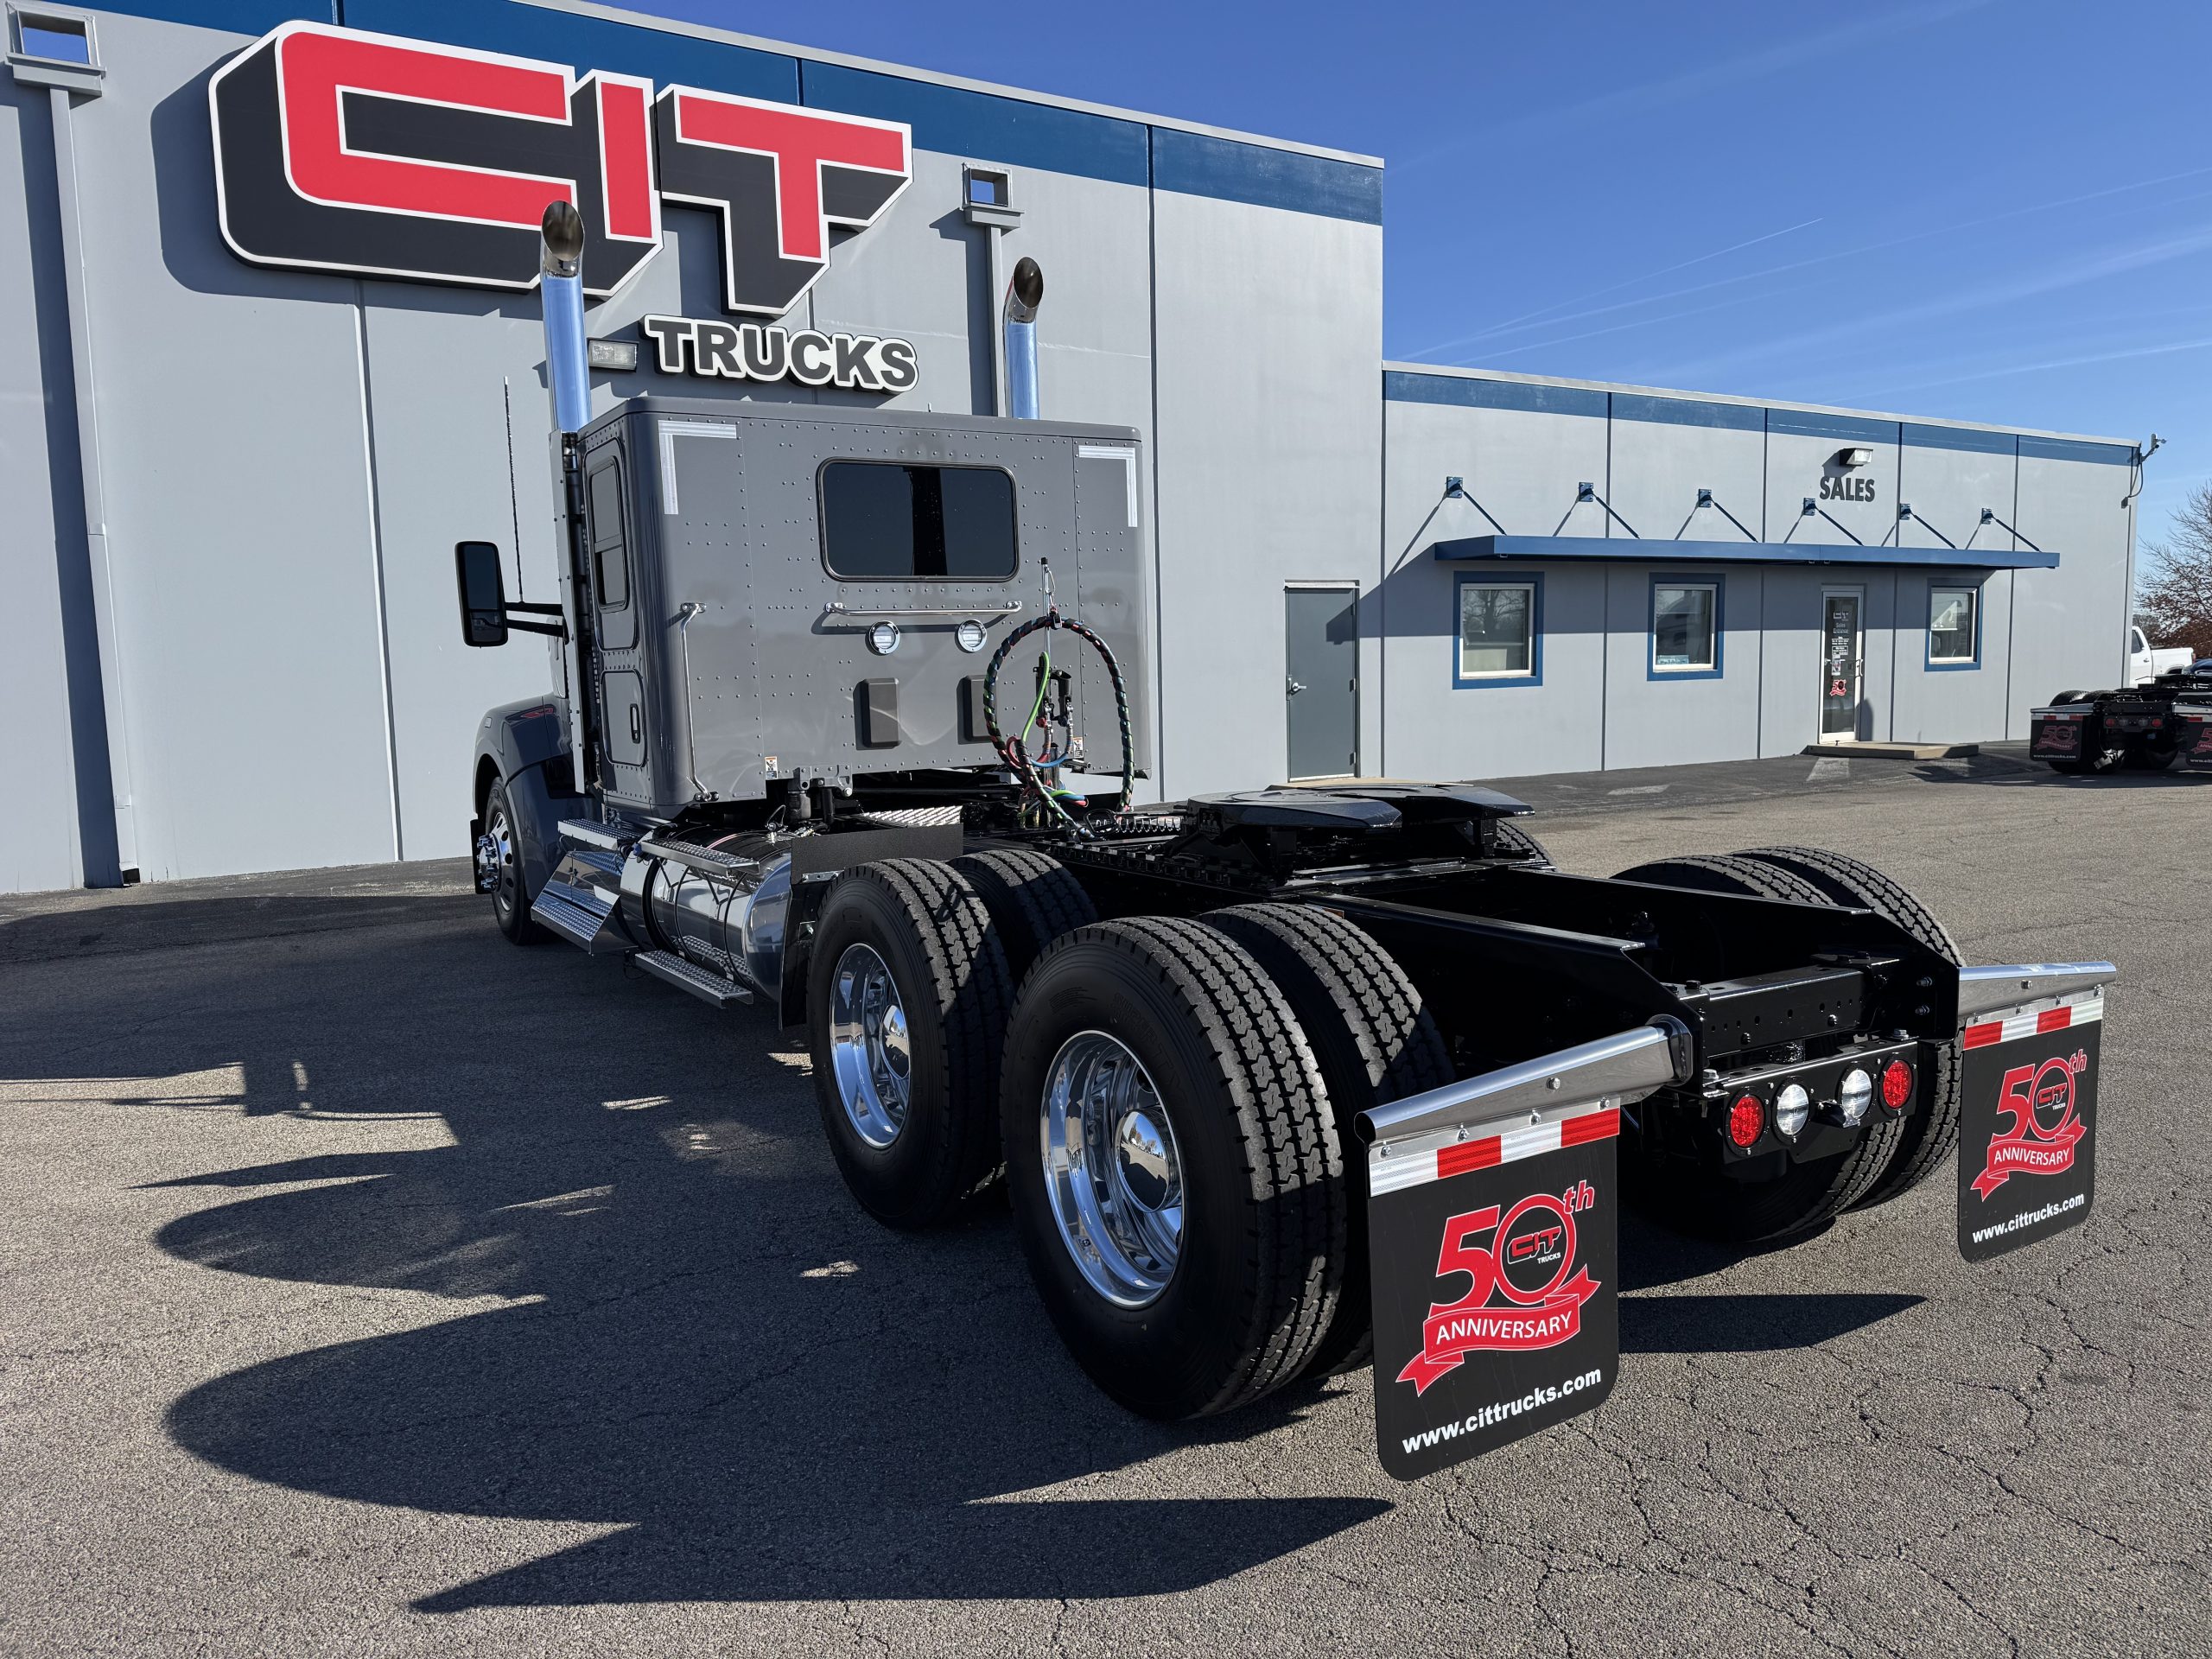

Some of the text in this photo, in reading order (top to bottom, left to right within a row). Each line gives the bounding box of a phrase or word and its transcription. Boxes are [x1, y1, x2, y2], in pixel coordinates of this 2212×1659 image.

[274, 21, 914, 264] CIT
[644, 315, 918, 394] TRUCKS
[1819, 476, 1876, 502] SALES
[2036, 1082, 2068, 1109] CIT
[1993, 1147, 2070, 1166] ANNIVERSARY
[1972, 1192, 2085, 1243] www.cittrucks.com
[1507, 1225, 1562, 1264] CIT
[1537, 1251, 1561, 1264] TRUCKS
[1435, 1310, 1573, 1345] ANNIVERSARY
[1402, 1368, 1602, 1454] www.cittrucks.com
